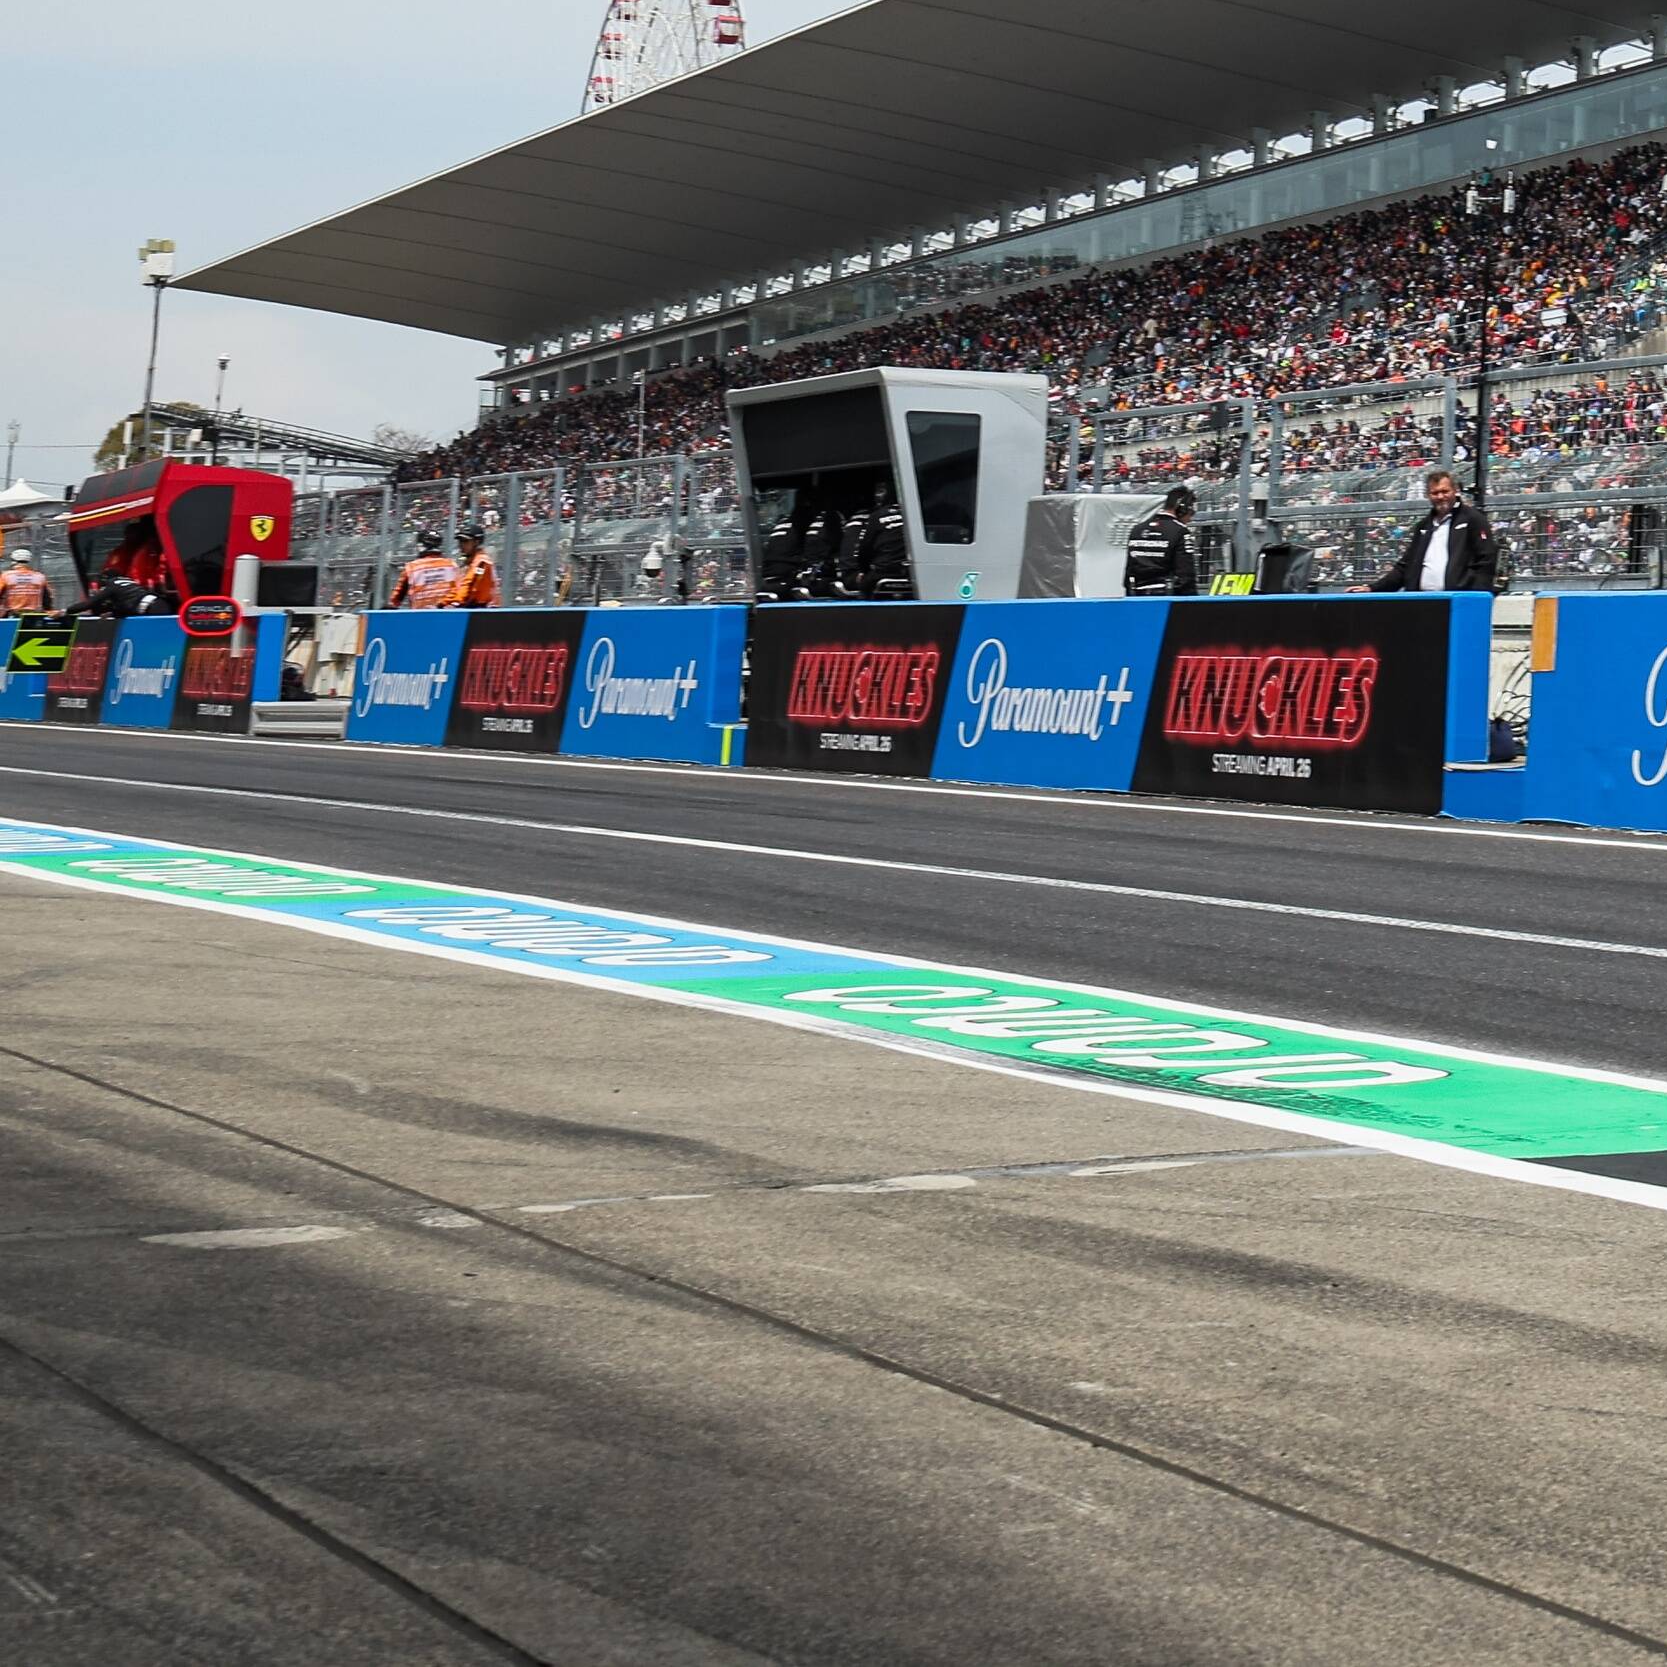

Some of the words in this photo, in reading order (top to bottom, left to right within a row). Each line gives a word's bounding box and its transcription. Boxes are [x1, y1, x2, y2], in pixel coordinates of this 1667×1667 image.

[787, 651, 941, 723] KNUCKLES
[958, 638, 1133, 748] Paramount+
[1164, 656, 1380, 743] KNUCKLES
[1212, 753, 1267, 776] STREAMING
[1268, 755, 1295, 777] APRIL
[1296, 757, 1311, 778] 26
